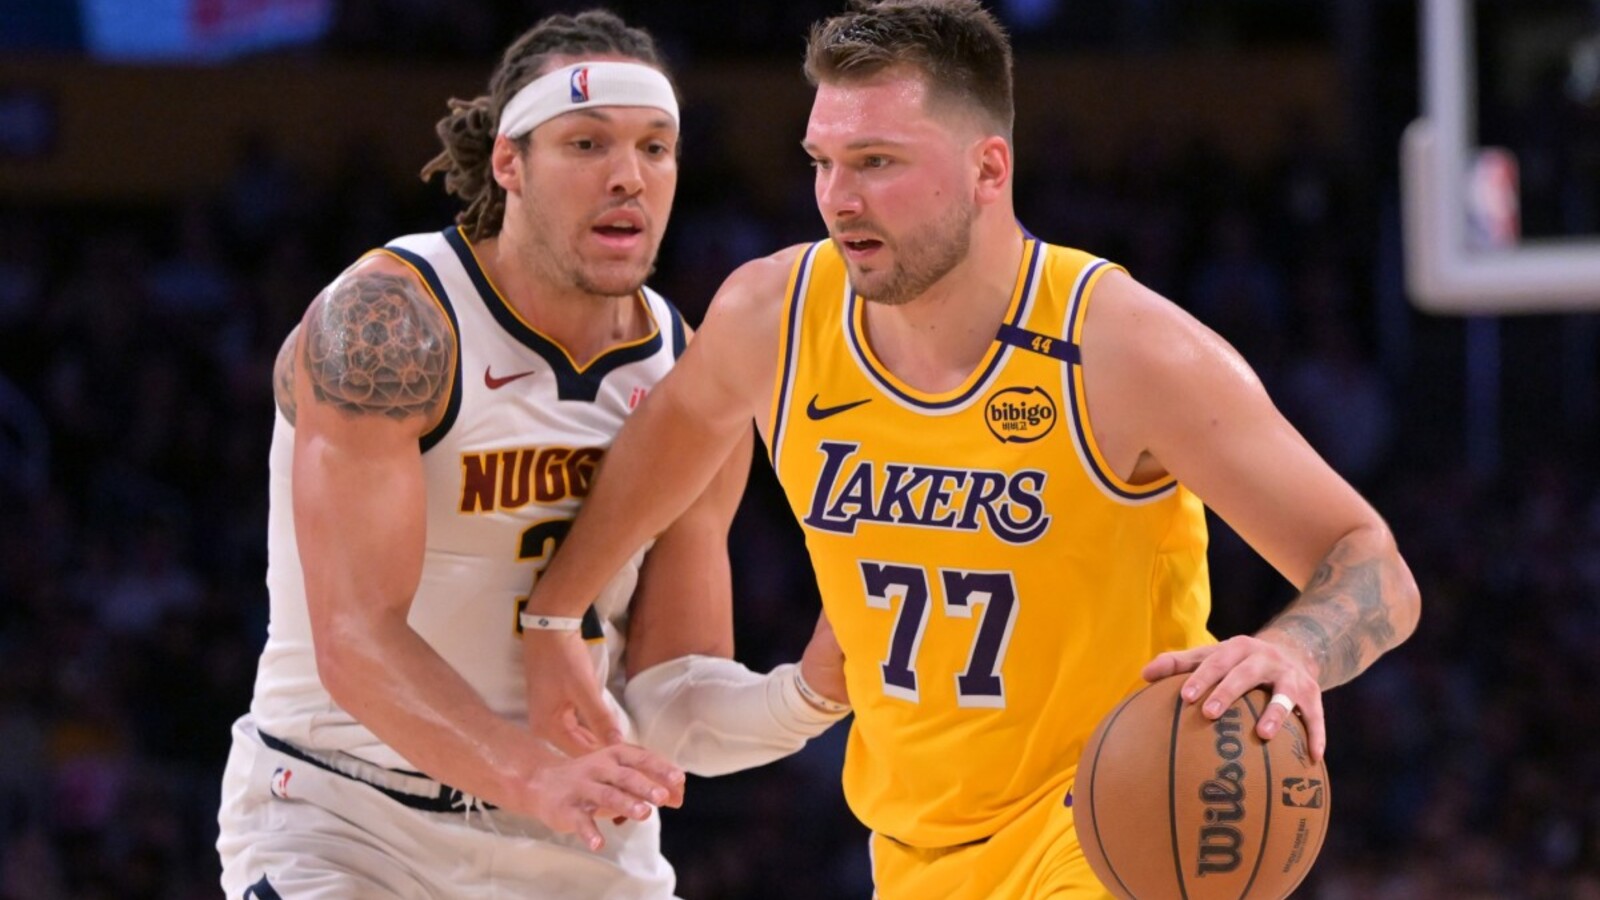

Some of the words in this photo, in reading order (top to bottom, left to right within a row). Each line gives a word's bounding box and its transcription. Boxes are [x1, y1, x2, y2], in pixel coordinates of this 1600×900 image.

[1031, 336, 1052, 354] 44
[991, 401, 1052, 426] bibigo
[458, 446, 607, 515] NUGG
[803, 439, 1052, 546] LAKERS
[857, 558, 1020, 709] 77
[1195, 706, 1247, 878] Wilson
